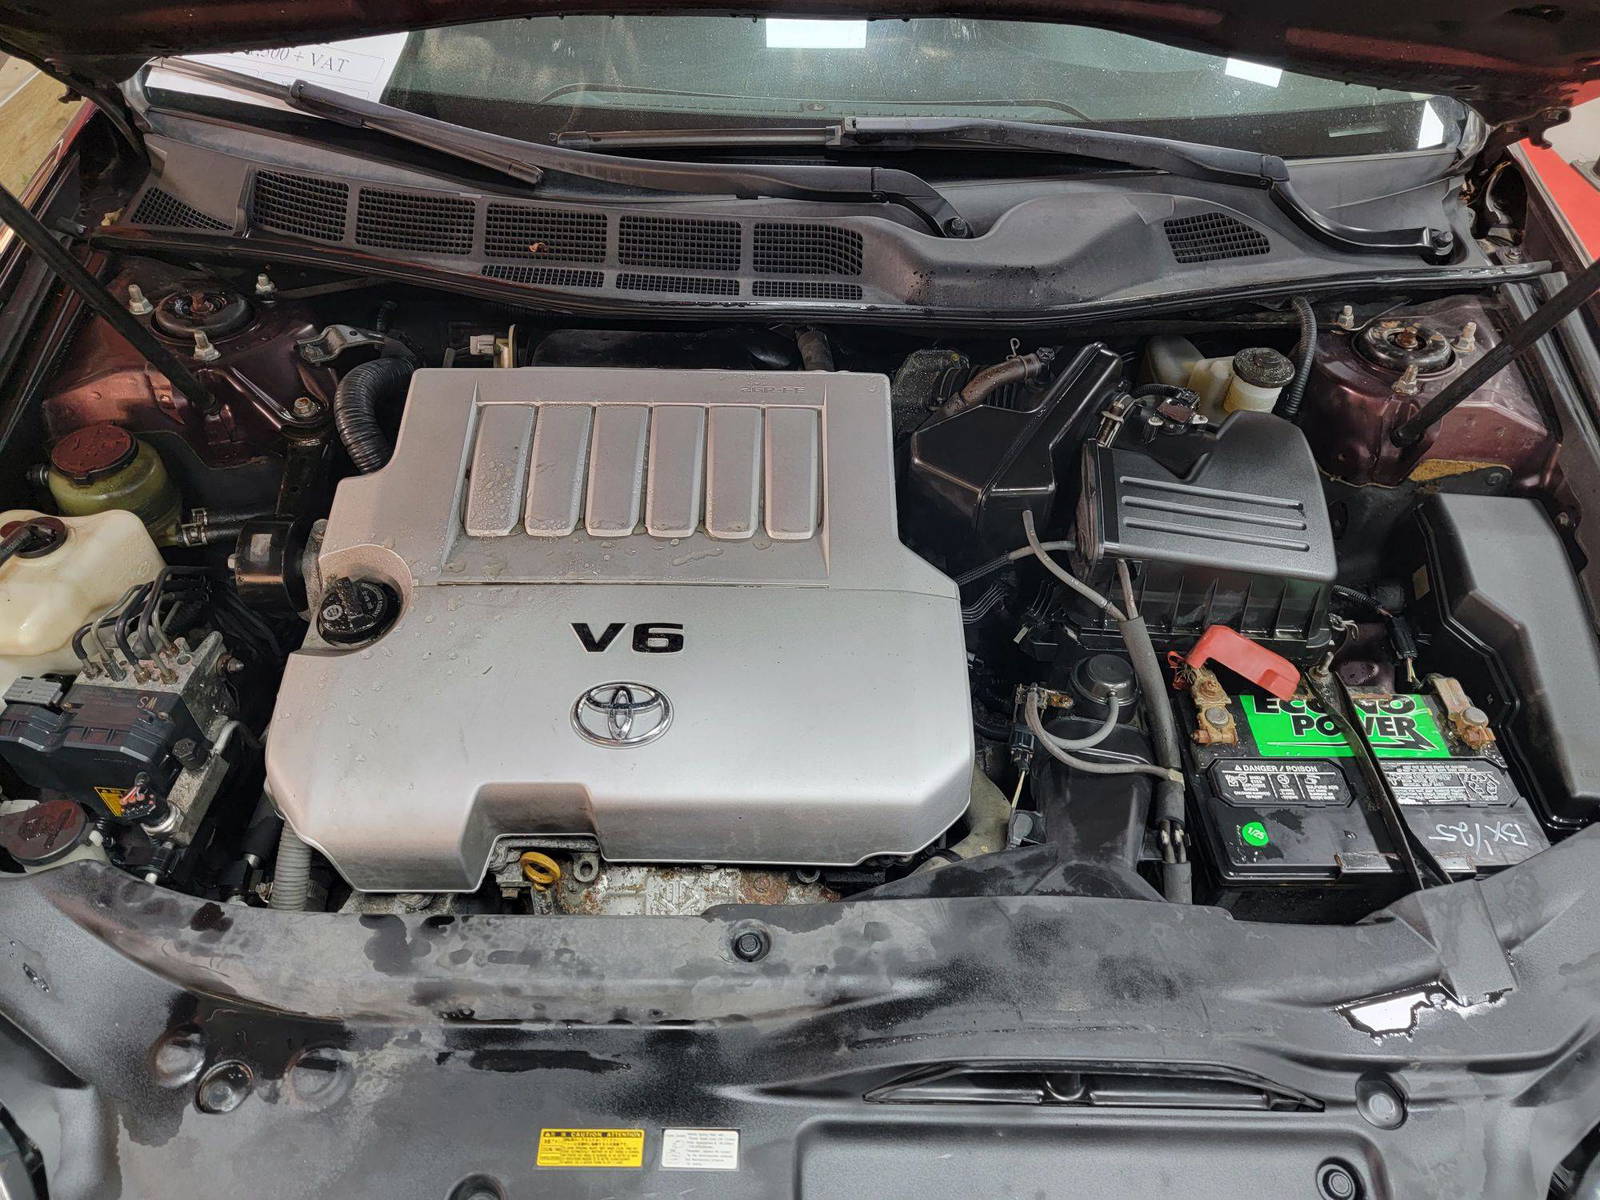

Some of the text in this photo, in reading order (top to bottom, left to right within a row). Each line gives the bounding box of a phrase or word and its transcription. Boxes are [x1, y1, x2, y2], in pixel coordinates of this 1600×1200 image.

[311, 52, 350, 73] VAT
[570, 622, 684, 653] V6
[1243, 764, 1279, 773] DANGER
[1285, 765, 1318, 773] POISON
[1247, 826, 1265, 840] 1/25
